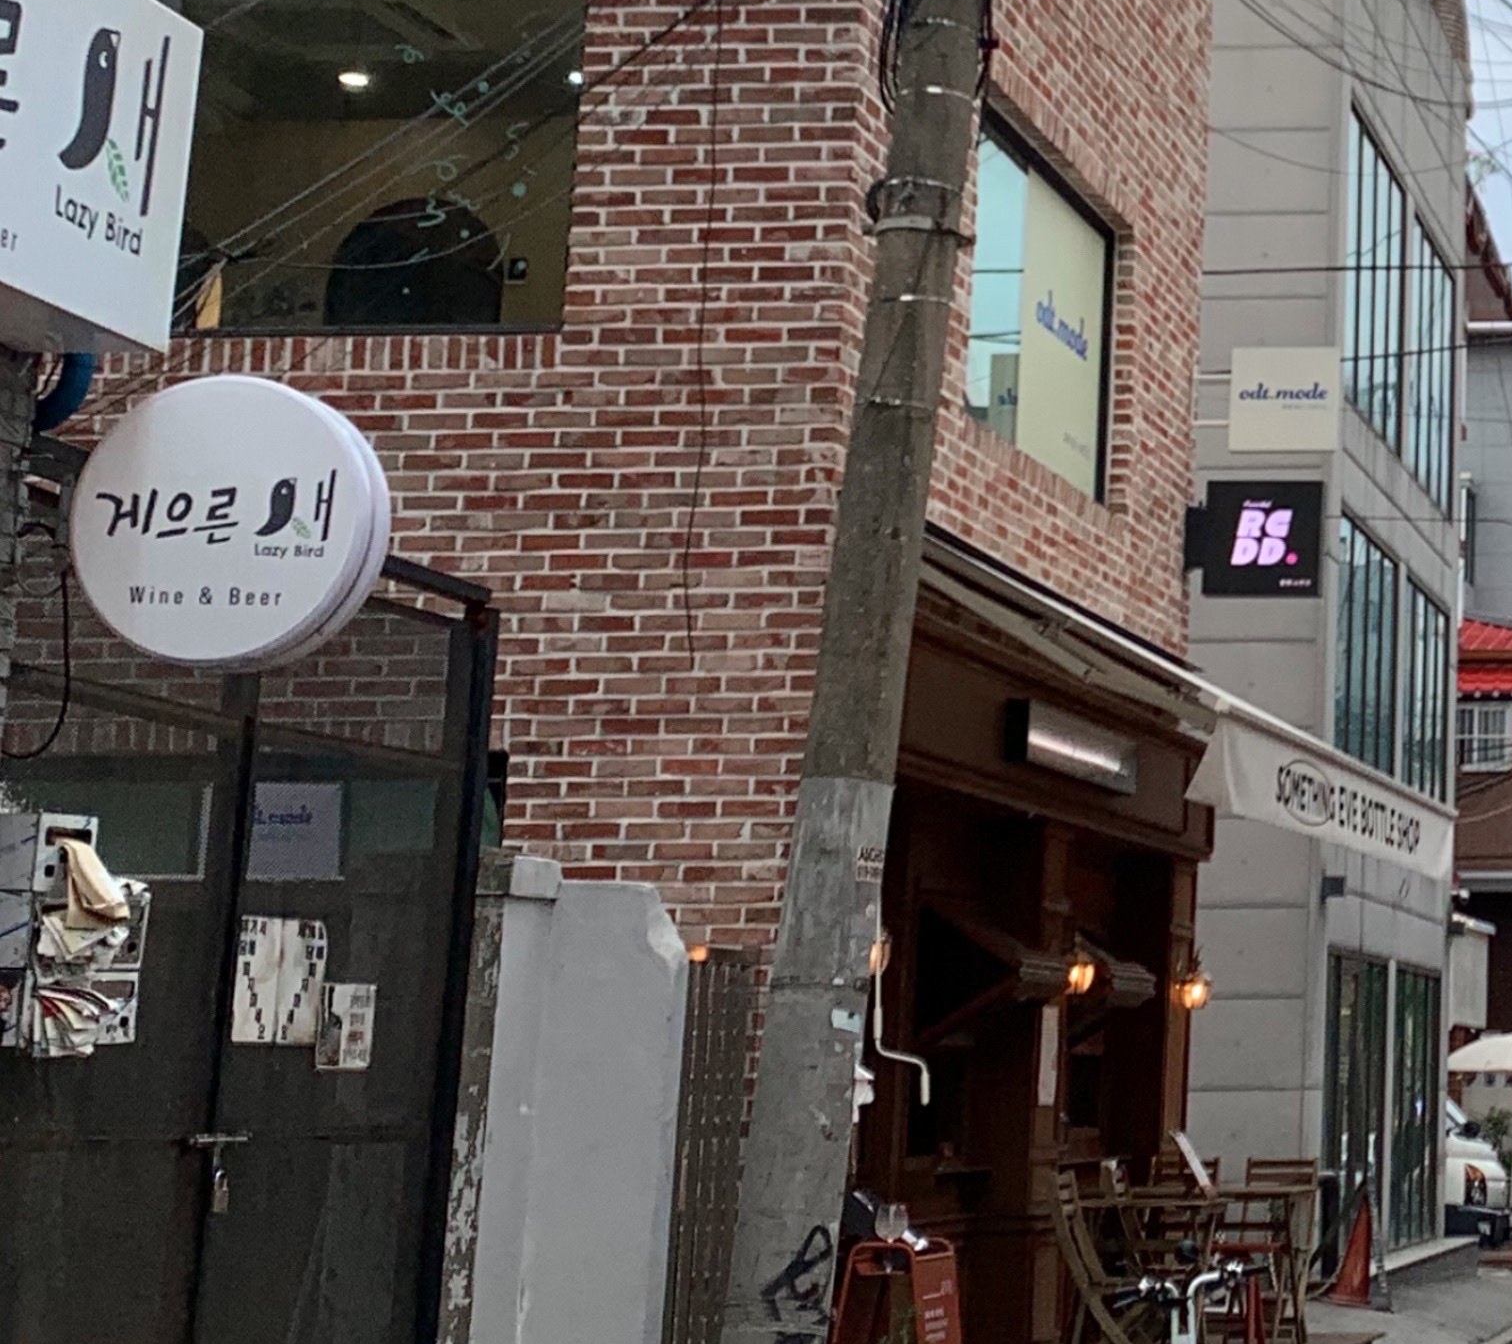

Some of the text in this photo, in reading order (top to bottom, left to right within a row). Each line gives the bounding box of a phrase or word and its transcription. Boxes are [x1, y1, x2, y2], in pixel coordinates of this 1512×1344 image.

[55, 184, 143, 256] Lazy Bird
[1037, 289, 1088, 361] odt.mode
[1239, 382, 1328, 401] odt.mode
[96, 487, 239, 544] 게으른
[255, 544, 324, 558] Lazy Bird
[129, 586, 282, 605] Wine & Beer
[1276, 765, 1421, 855] SOMETHING EVE BOTTLE SHOP
